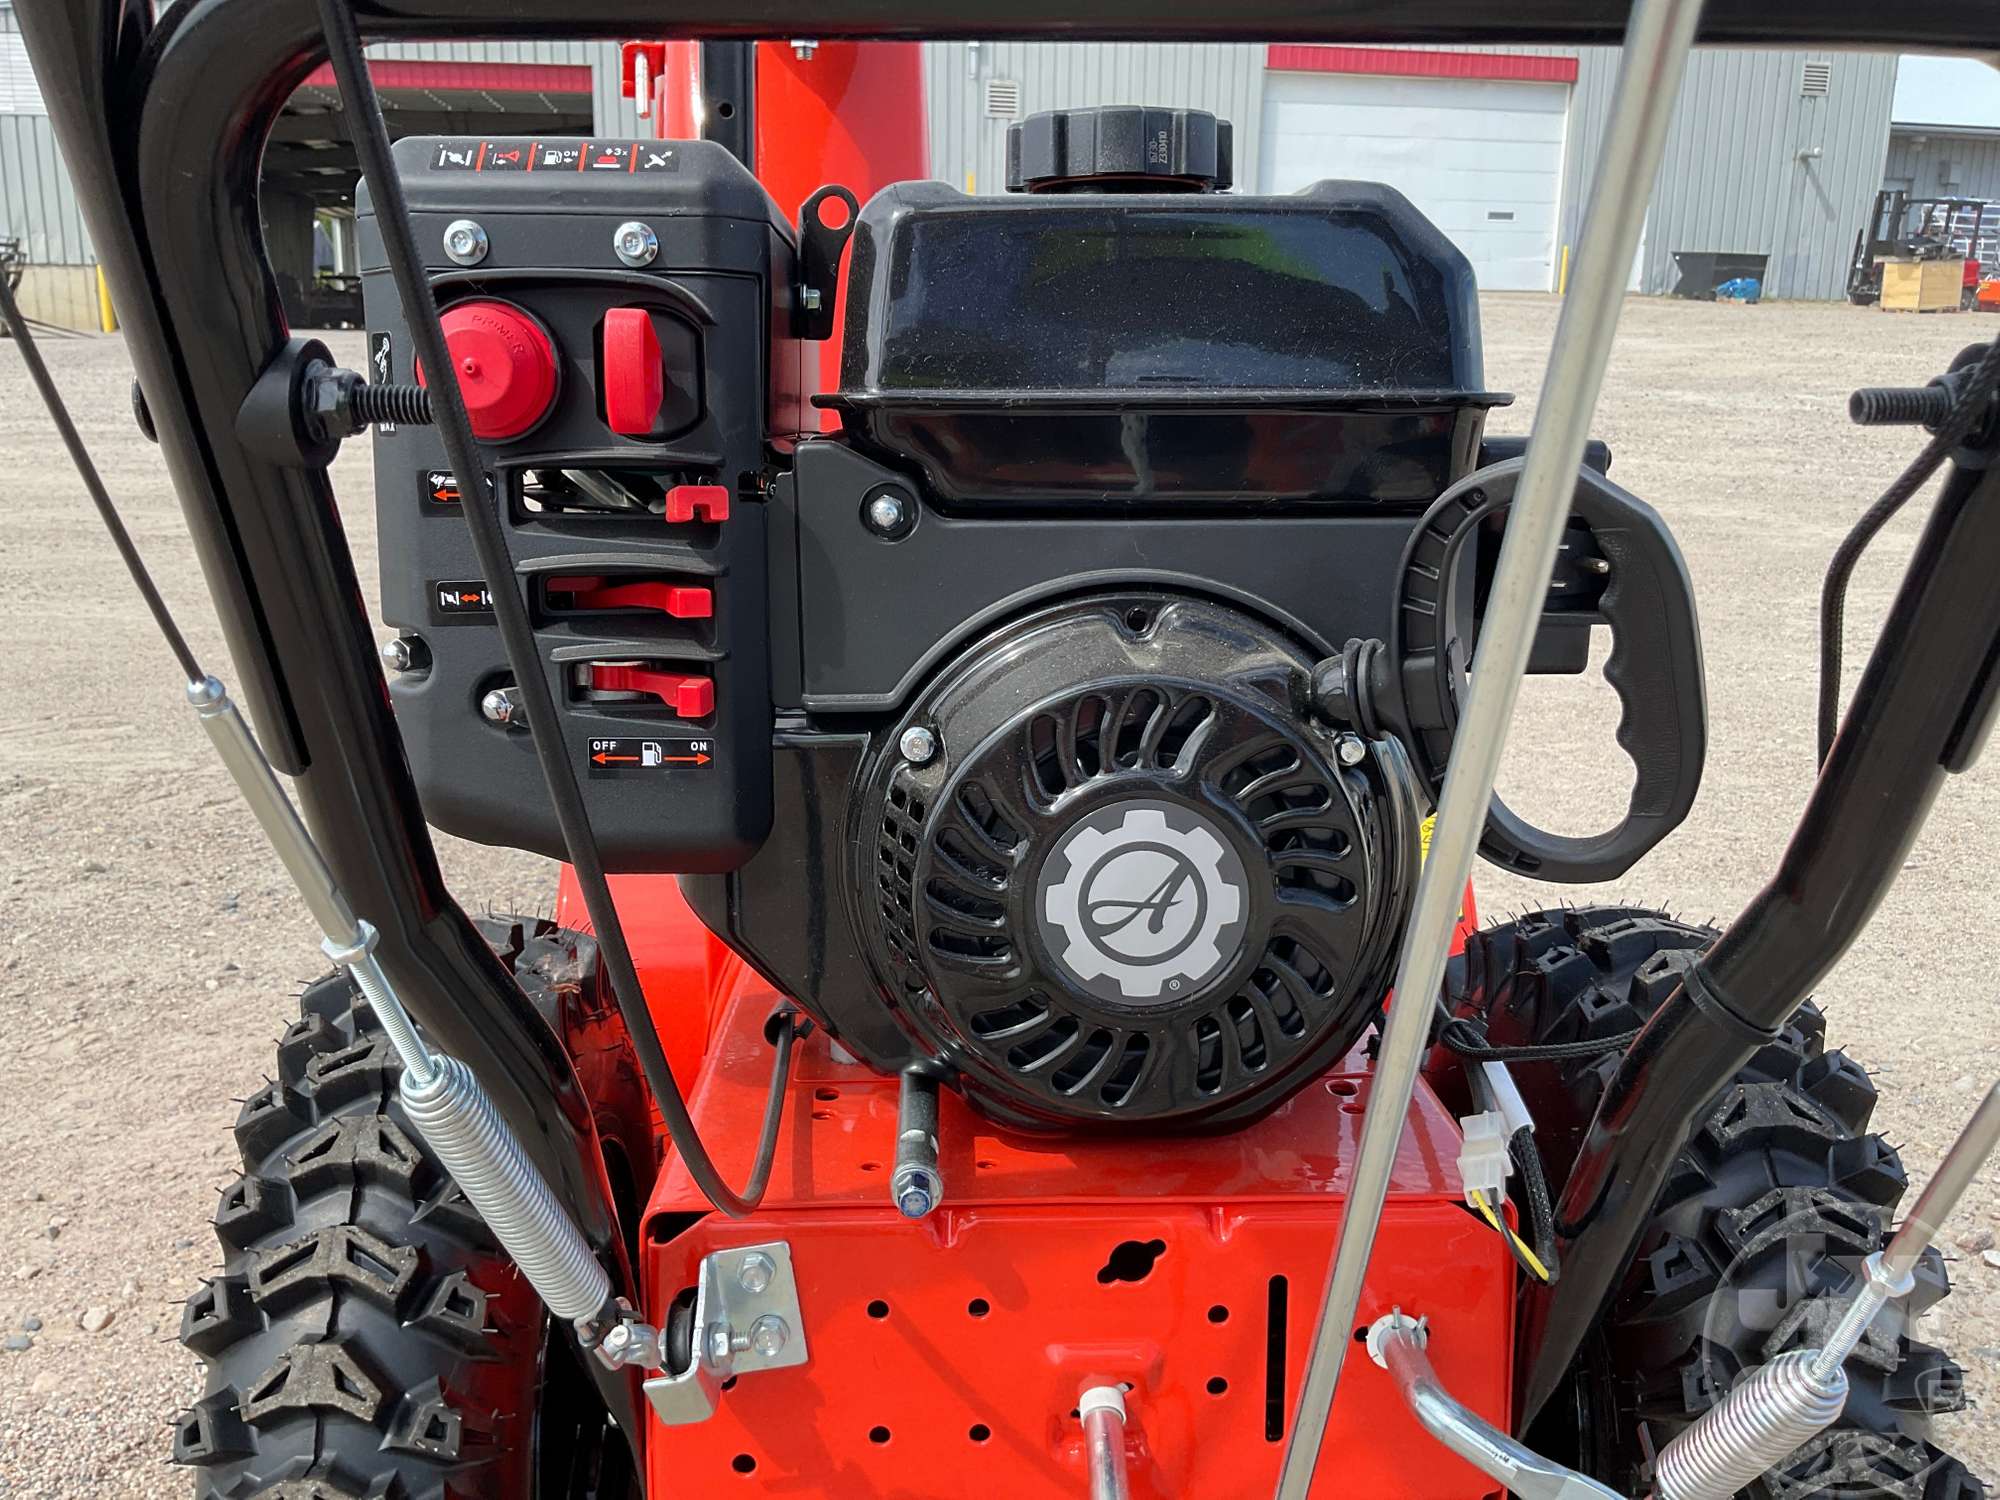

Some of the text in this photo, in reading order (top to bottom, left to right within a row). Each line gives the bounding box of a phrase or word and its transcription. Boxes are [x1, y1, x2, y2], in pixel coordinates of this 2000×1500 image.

[471, 314, 525, 355] PRIMER
[592, 741, 707, 751] OFF ON
